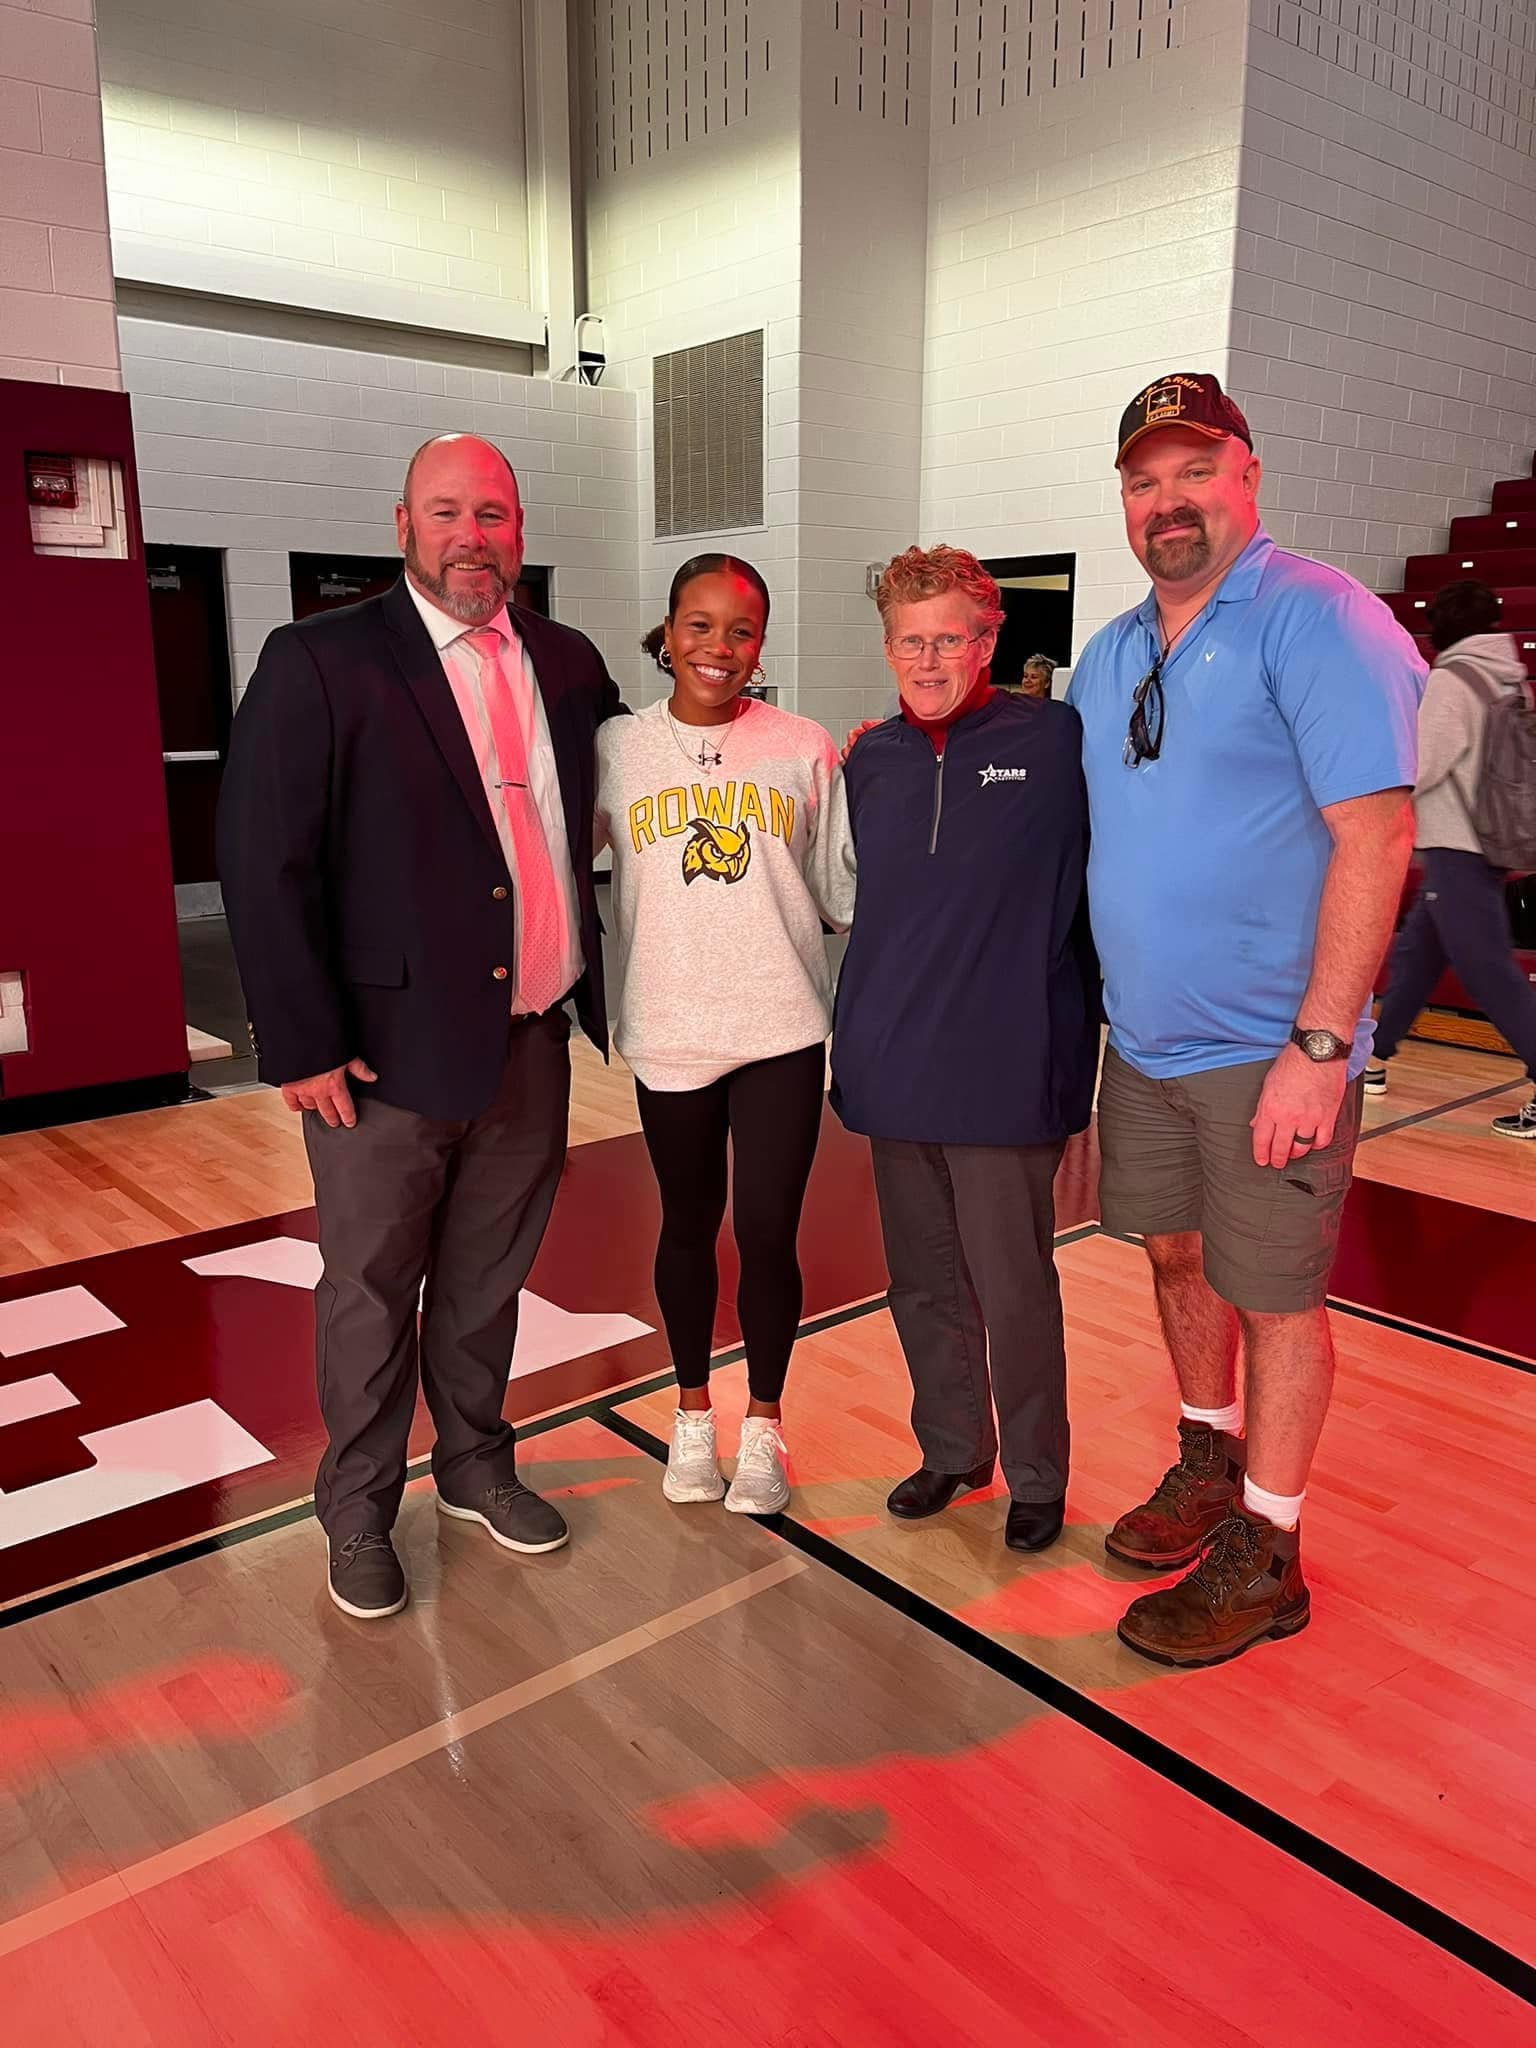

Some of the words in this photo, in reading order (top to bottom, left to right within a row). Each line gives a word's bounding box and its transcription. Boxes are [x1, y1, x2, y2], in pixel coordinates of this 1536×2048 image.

[1161, 376, 1201, 389] ARMY
[990, 768, 1027, 777] STARS
[629, 781, 795, 854] ROWAN
